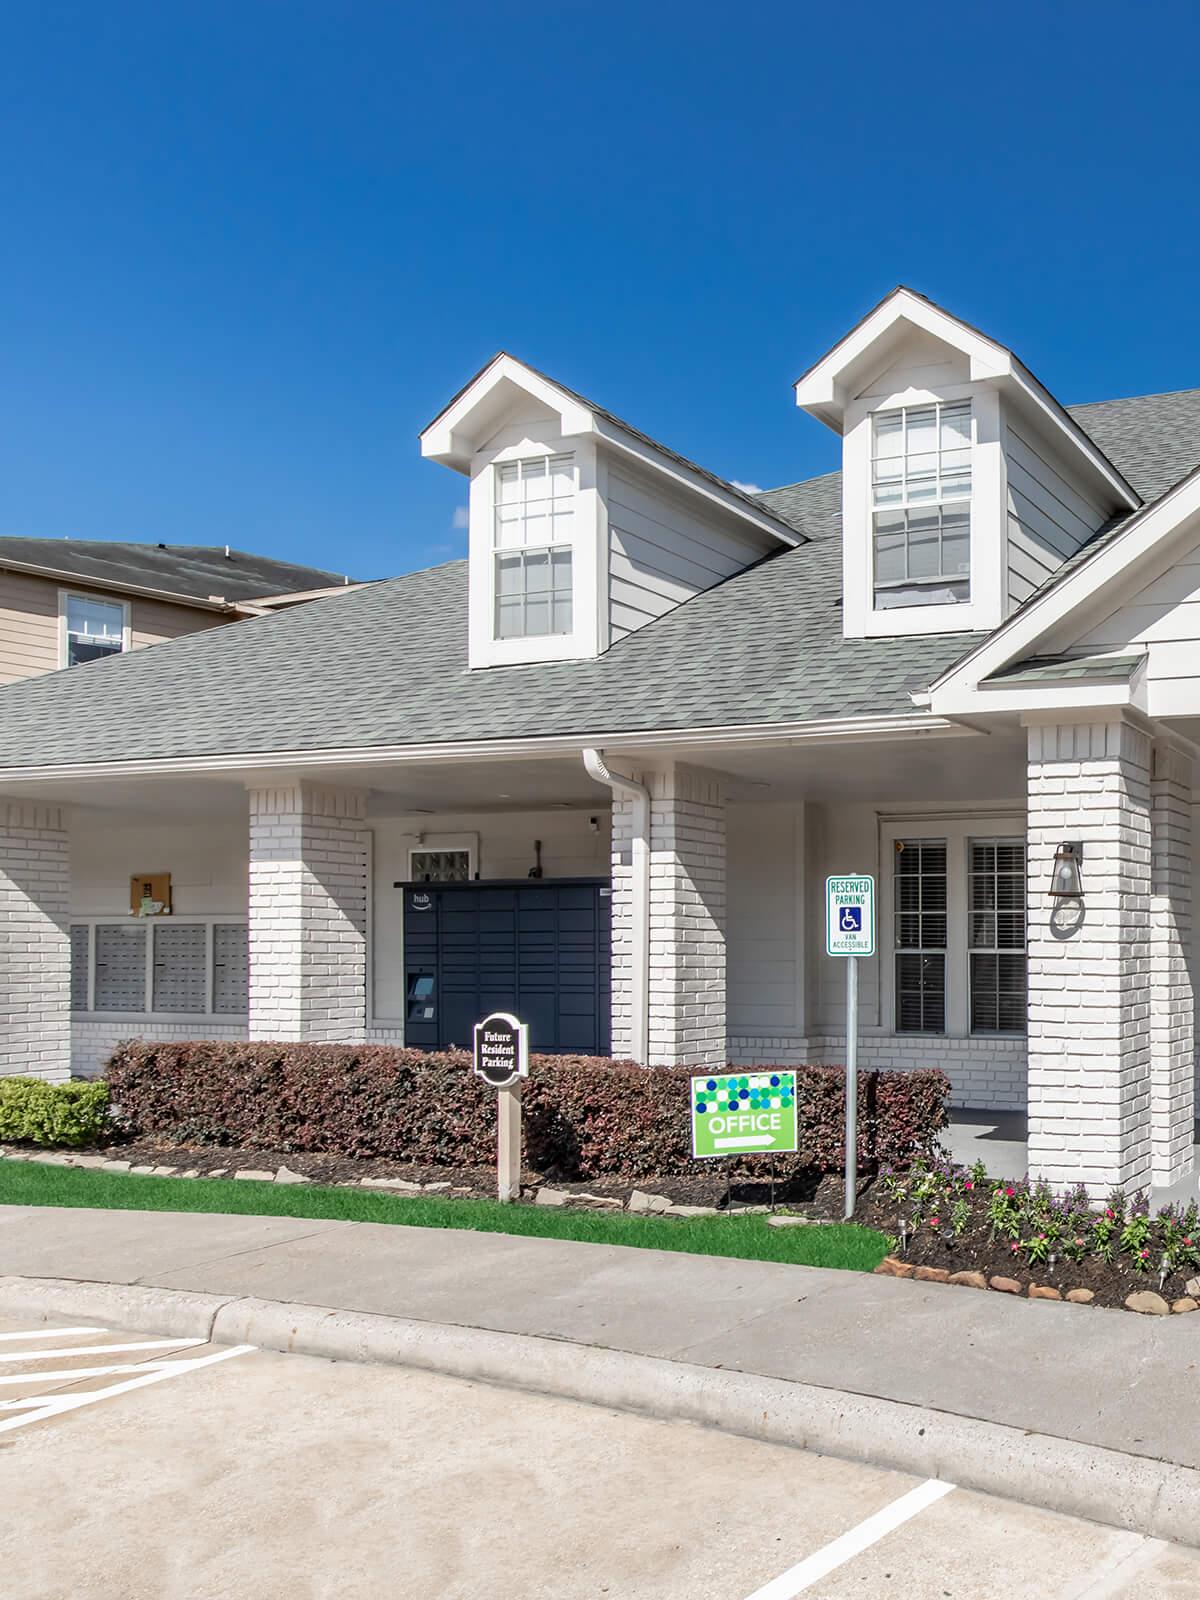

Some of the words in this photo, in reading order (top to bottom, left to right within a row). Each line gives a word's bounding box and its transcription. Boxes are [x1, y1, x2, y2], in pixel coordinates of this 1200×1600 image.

[831, 881, 869, 893] RESERVED
[413, 893, 429, 903] hub
[836, 895, 865, 905] PARKING
[485, 1032, 511, 1041] Future
[481, 1044, 514, 1055] Resident
[482, 1057, 513, 1070] Parking
[708, 1113, 782, 1134] OFFICE
